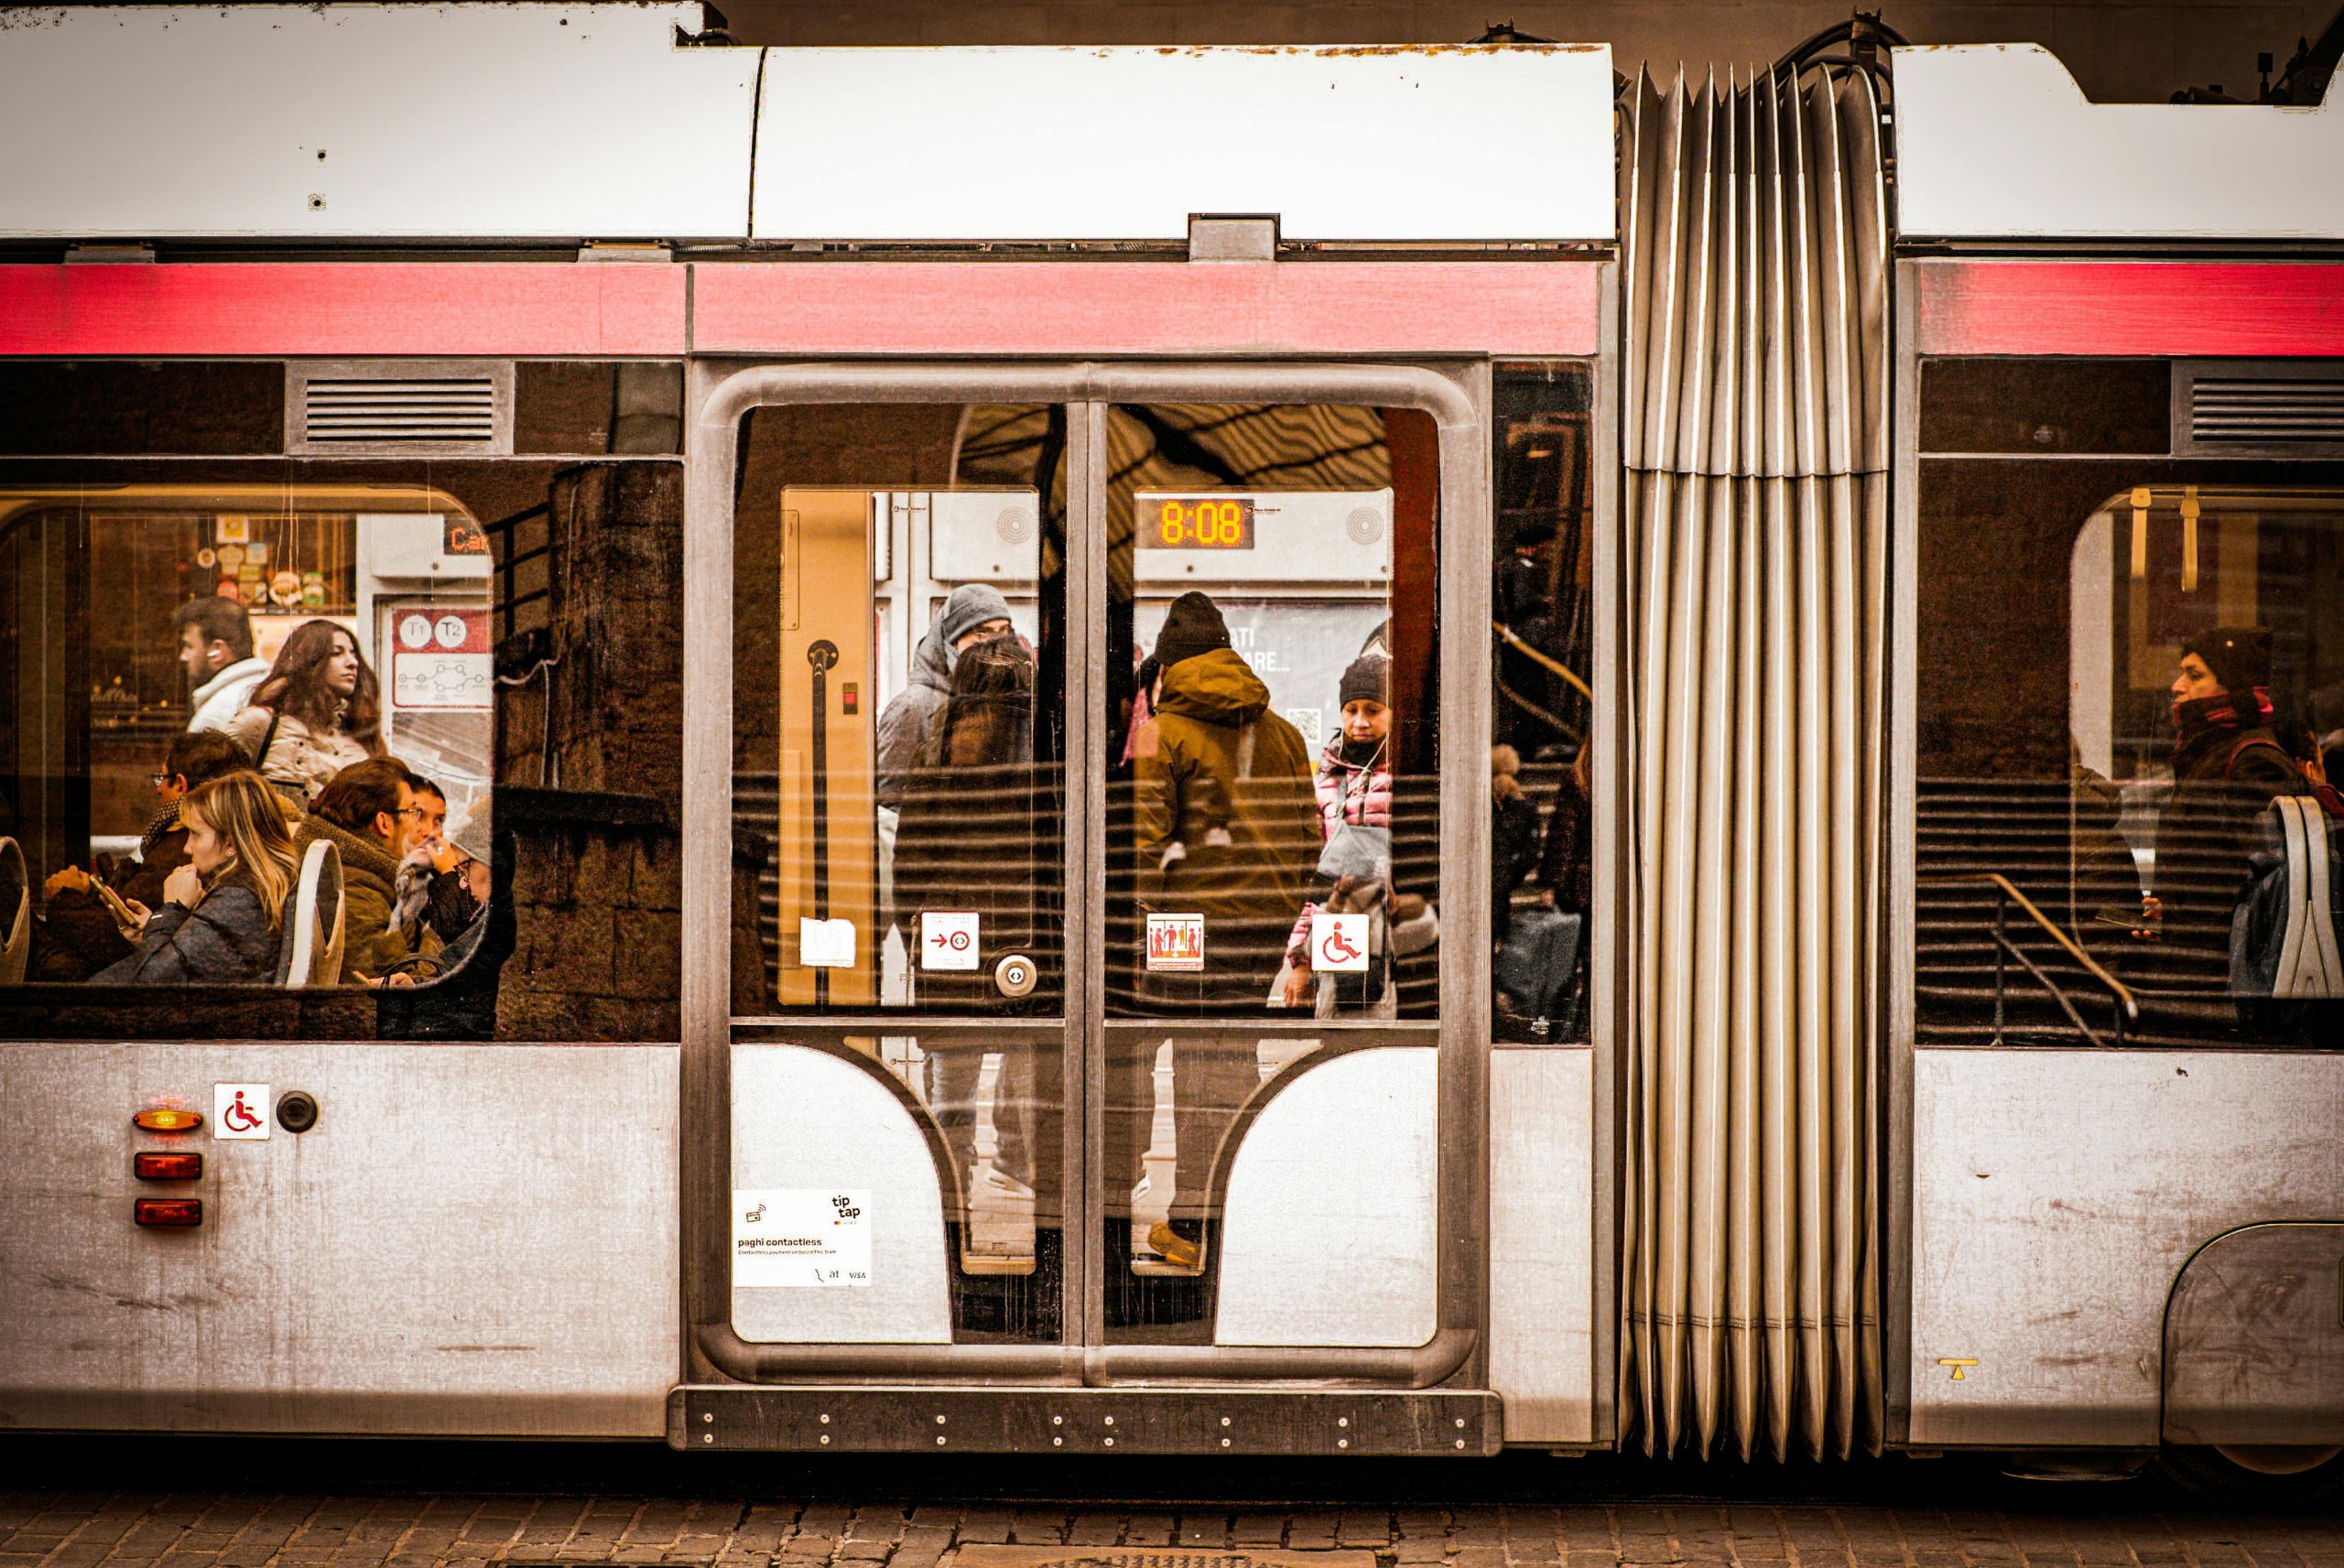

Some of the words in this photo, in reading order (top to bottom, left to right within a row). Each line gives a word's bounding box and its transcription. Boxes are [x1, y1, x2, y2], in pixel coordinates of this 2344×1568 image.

[1161, 501, 1242, 545] 8:08
[407, 622, 425, 637] T1
[441, 622, 461, 637] T2
[831, 1195, 851, 1208] tip
[838, 1207, 861, 1219] tap
[738, 1238, 765, 1249] paghi
[765, 1238, 822, 1247] contactless
[829, 1270, 840, 1279] at
[849, 1271, 866, 1280] VISA
